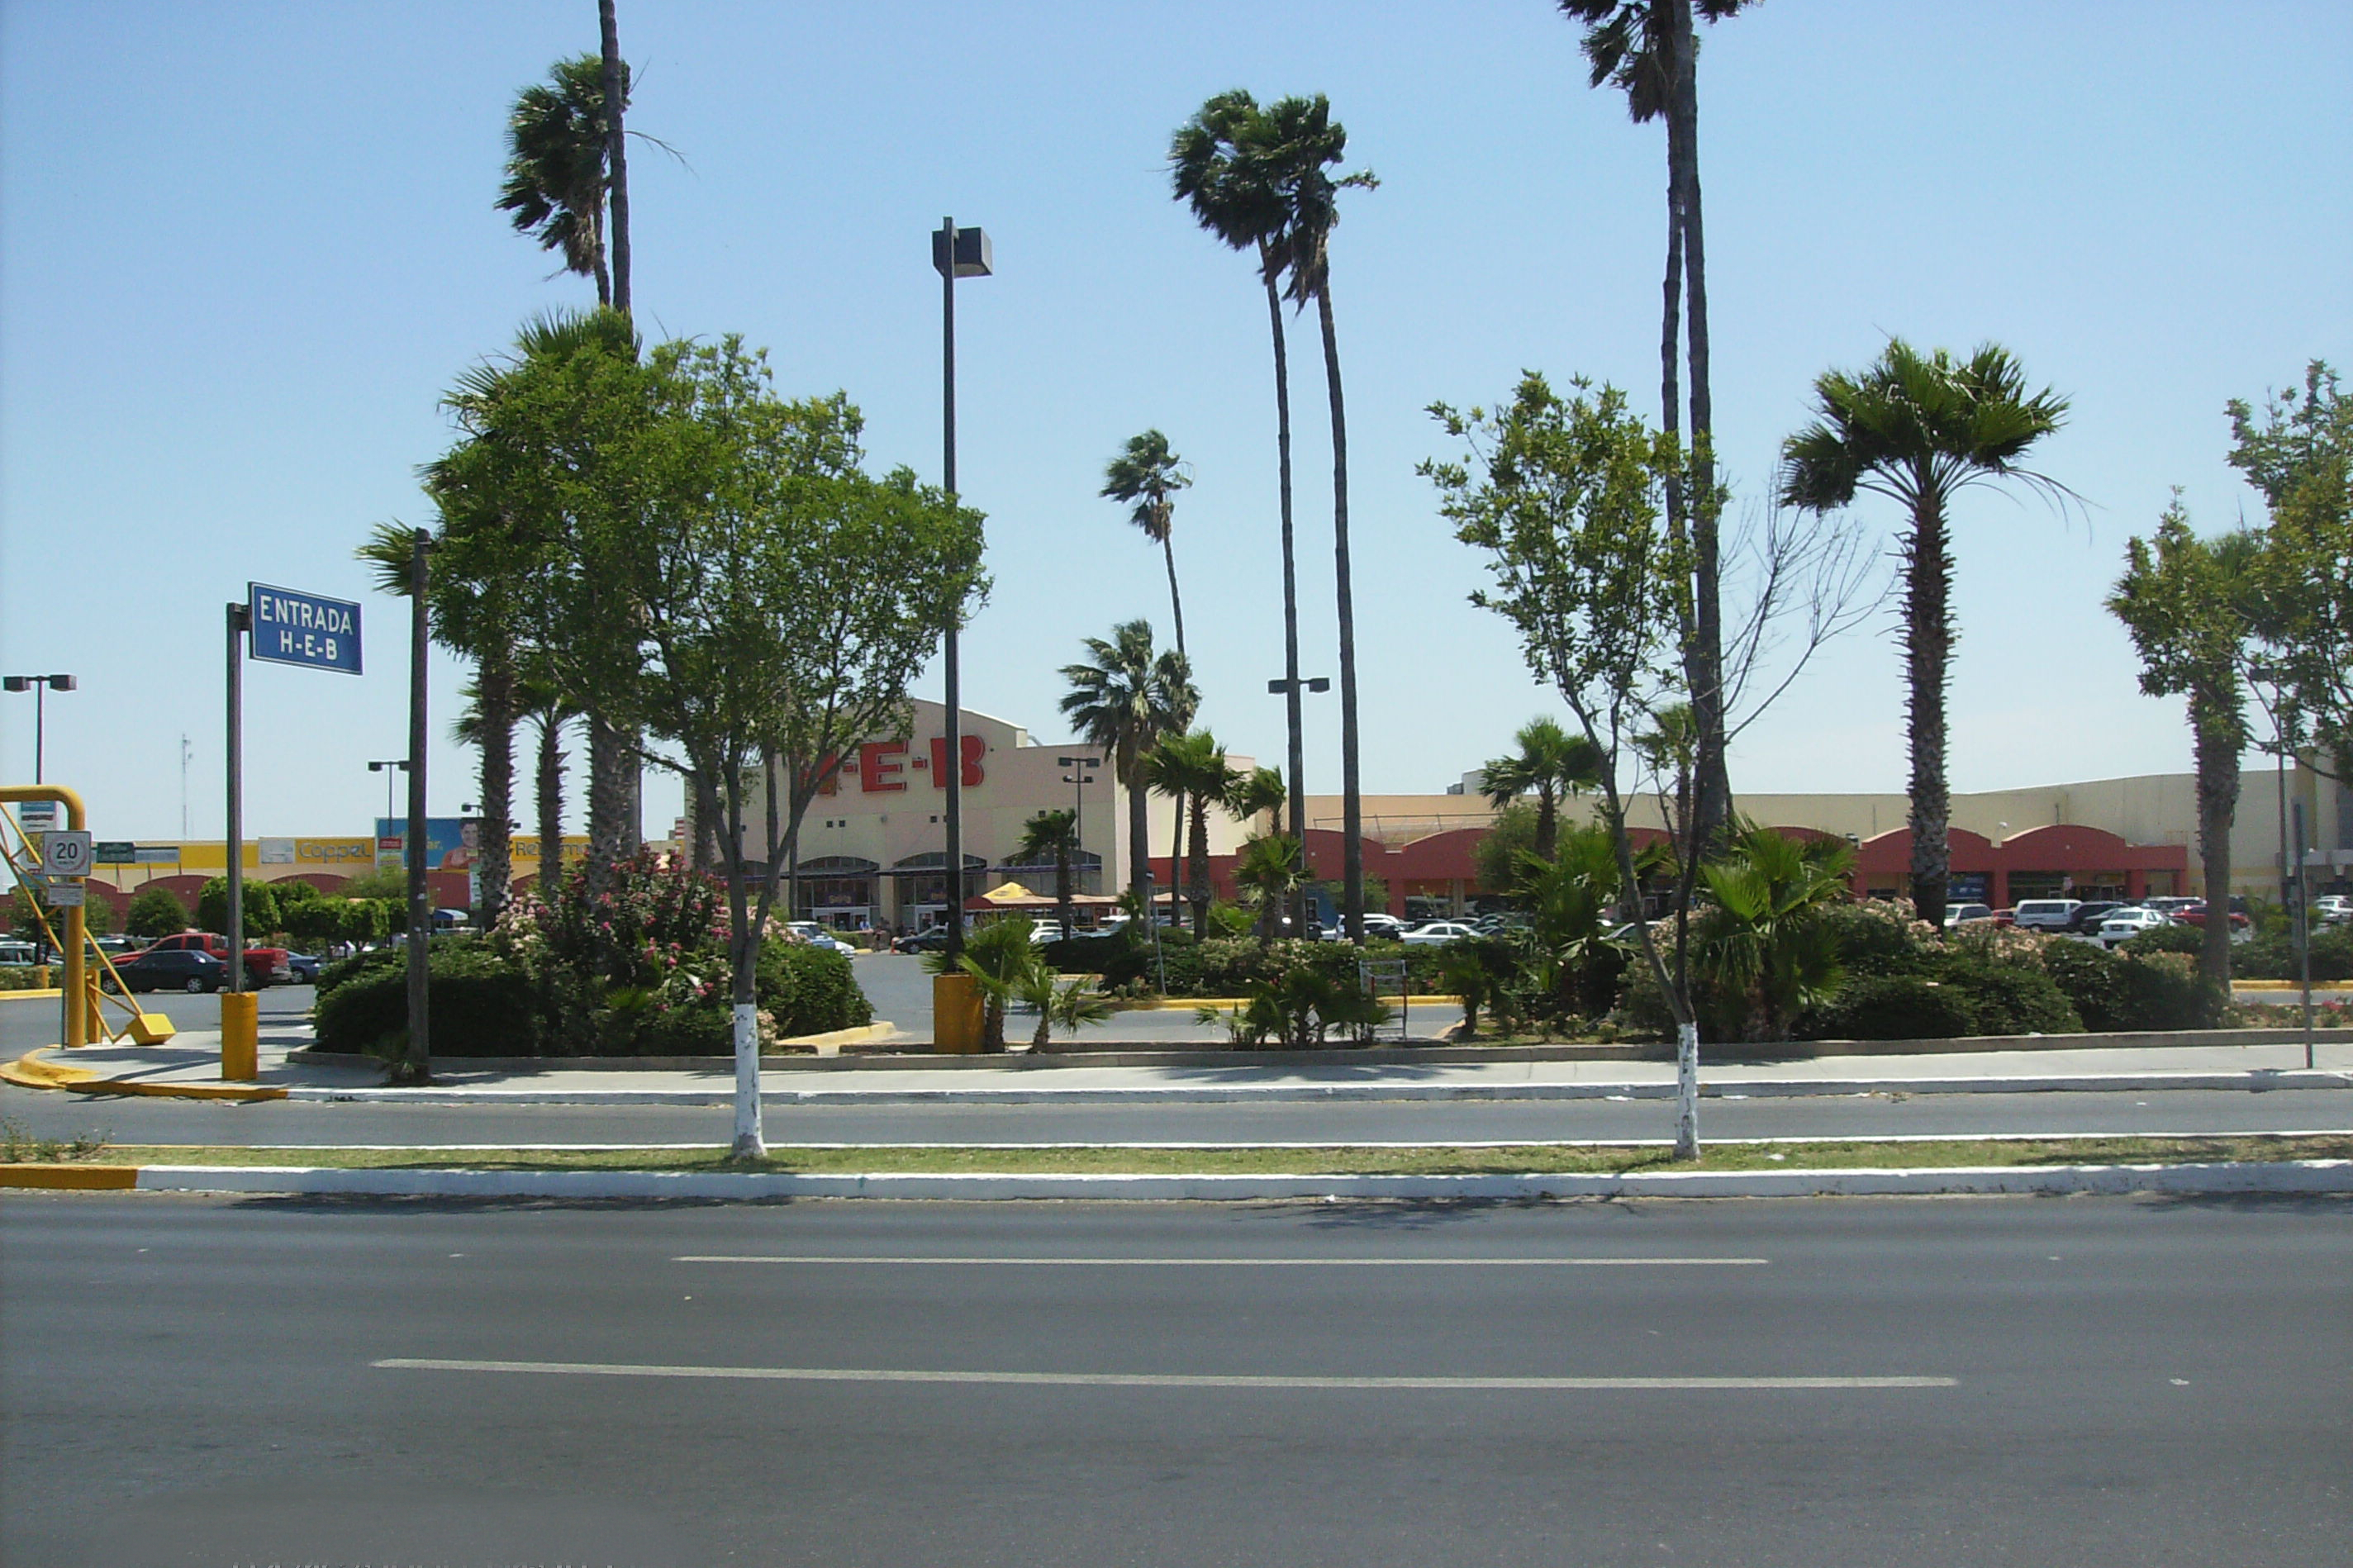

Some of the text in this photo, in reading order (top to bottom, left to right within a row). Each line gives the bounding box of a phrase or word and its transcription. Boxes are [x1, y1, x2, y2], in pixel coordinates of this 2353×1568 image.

[260, 595, 353, 635] ENTRADA
[280, 630, 338, 660] H-E-B
[56, 843, 78, 859] 20
[299, 843, 371, 863] Coppel
